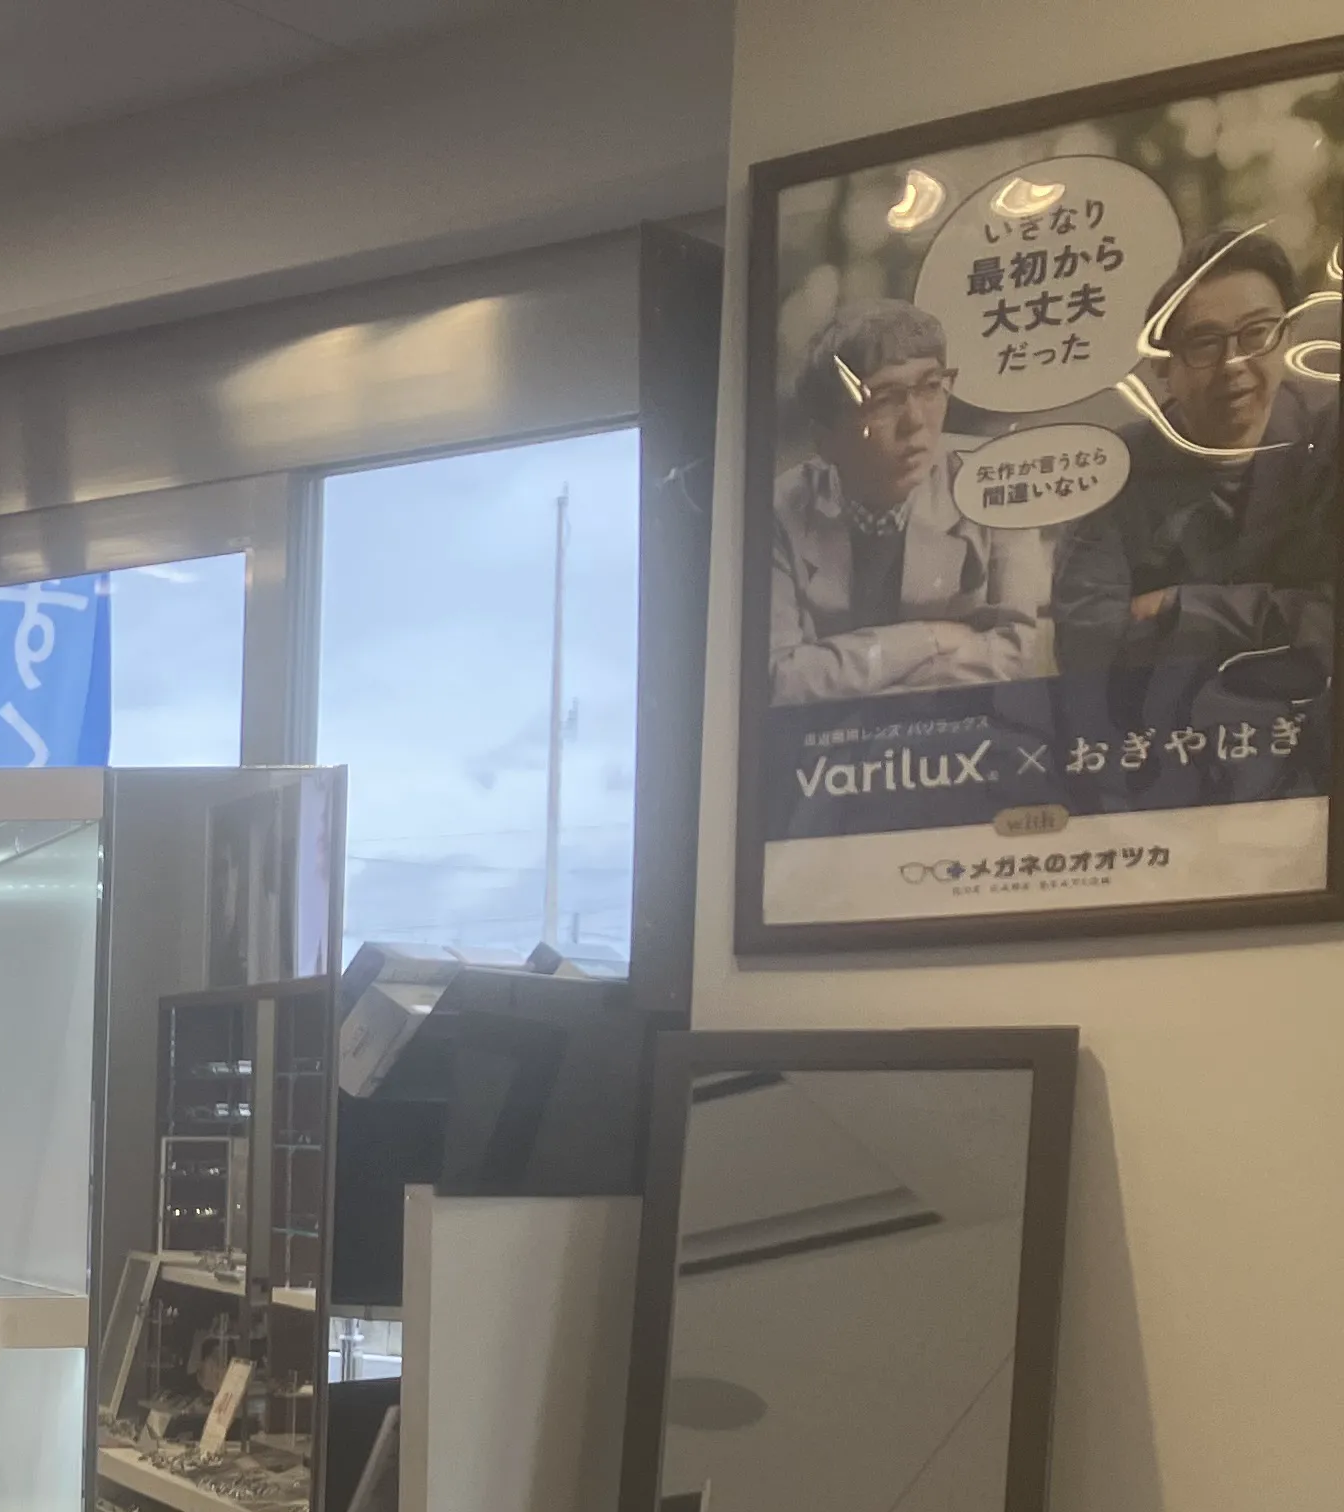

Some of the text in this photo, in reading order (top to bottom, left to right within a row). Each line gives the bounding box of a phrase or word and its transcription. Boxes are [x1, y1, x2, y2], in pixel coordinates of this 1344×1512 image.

[983, 196, 1107, 246] いきなり
[966, 235, 1126, 298] 最初から
[981, 282, 1107, 340] 大丈夫
[997, 332, 1092, 375] だった
[981, 472, 1100, 510] 間違いない
[1066, 710, 1306, 776] おぎやはぎ
[969, 844, 1172, 881] メガネのオオツカ
